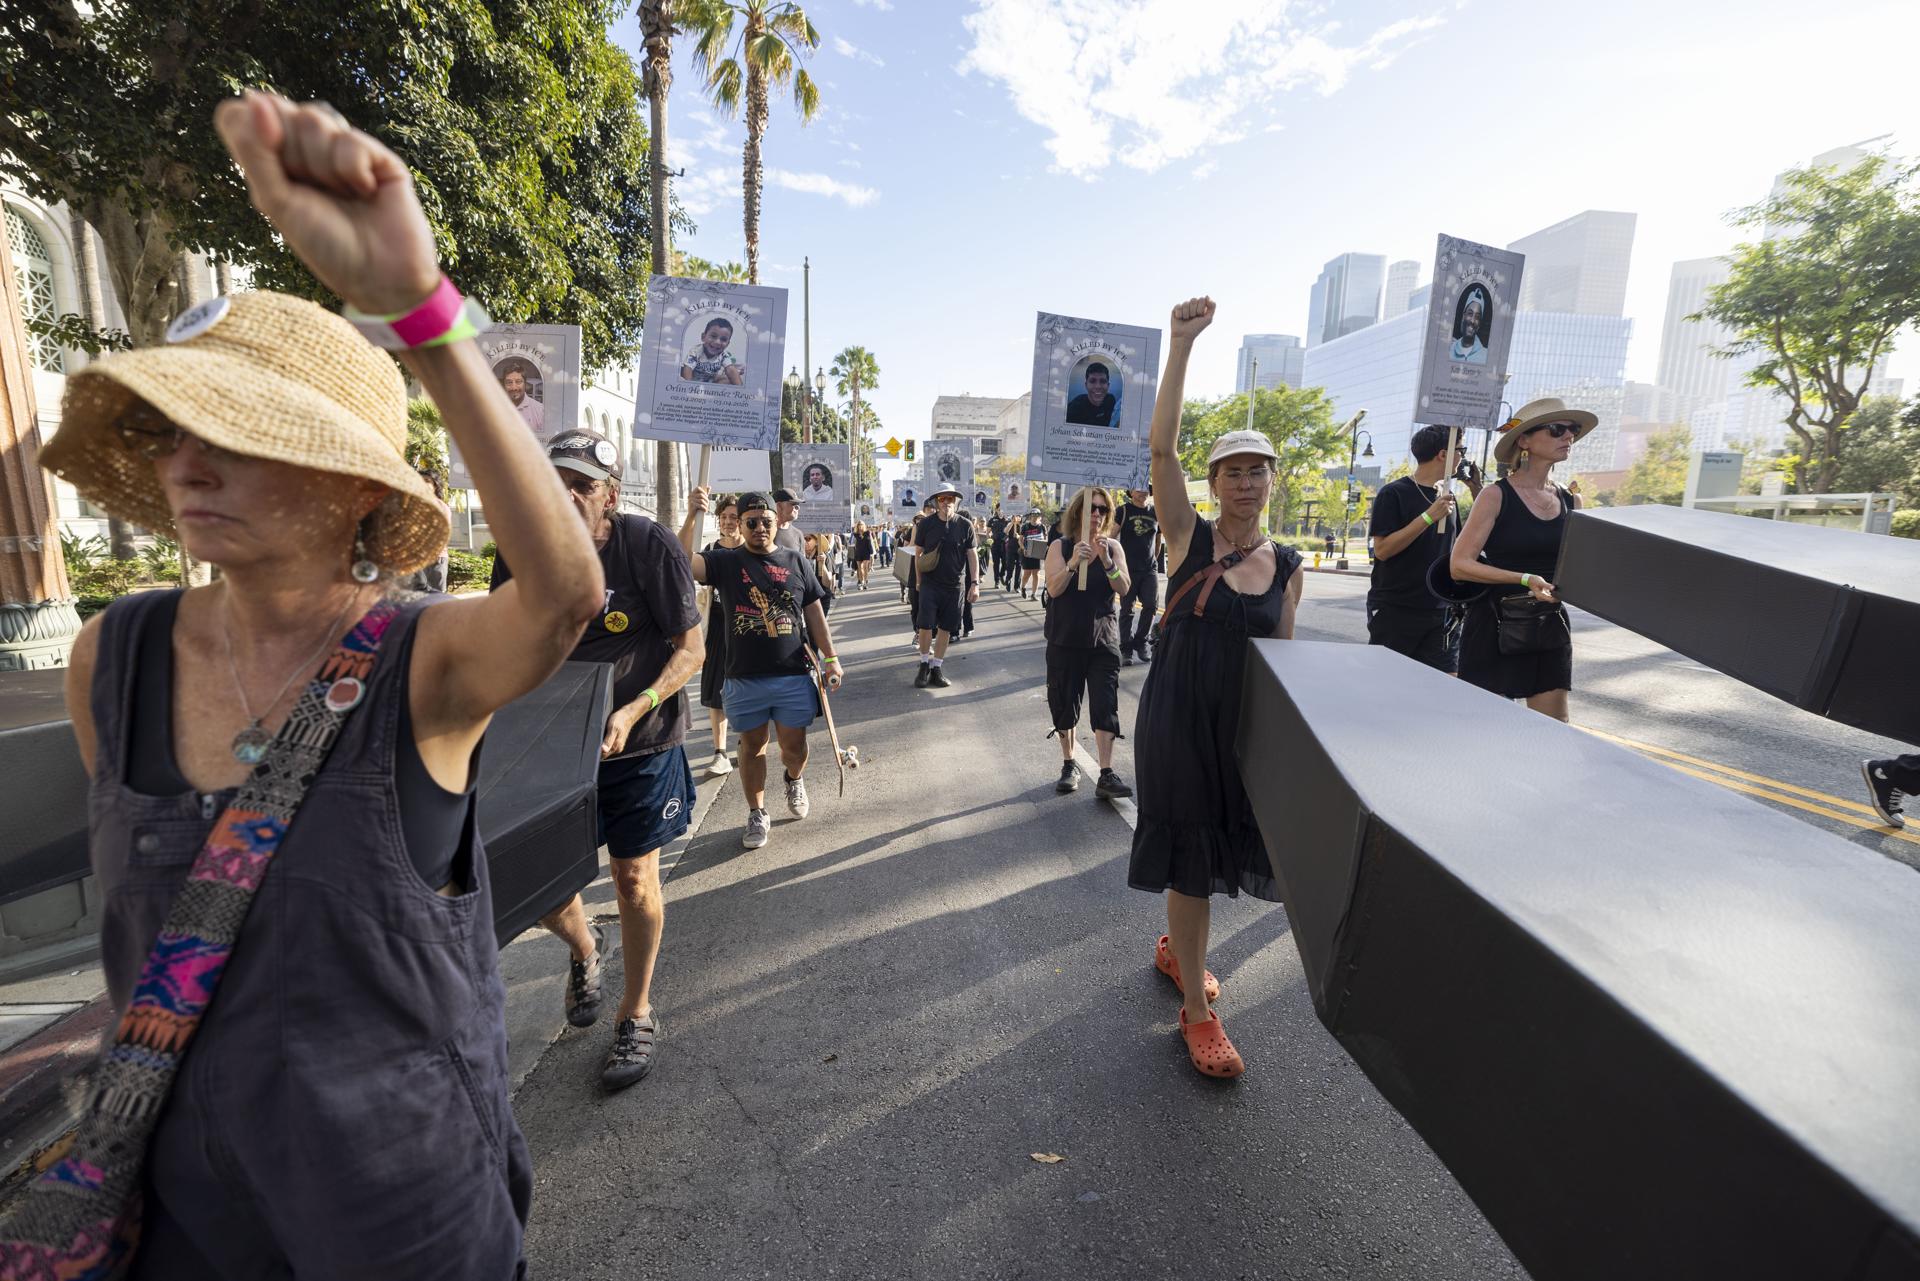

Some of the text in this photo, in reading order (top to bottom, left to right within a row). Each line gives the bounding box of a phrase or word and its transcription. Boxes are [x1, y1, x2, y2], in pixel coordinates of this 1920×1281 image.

[686, 302, 720, 315] KILLED
[736, 307, 750, 322] ICE
[486, 343, 546, 362] KILLED BY ICE
[1070, 341, 1128, 362] KILLED BY ICE
[666, 384, 687, 393] Orlin
[689, 387, 731, 398] Hernandez
[1050, 426, 1071, 436] Johan
